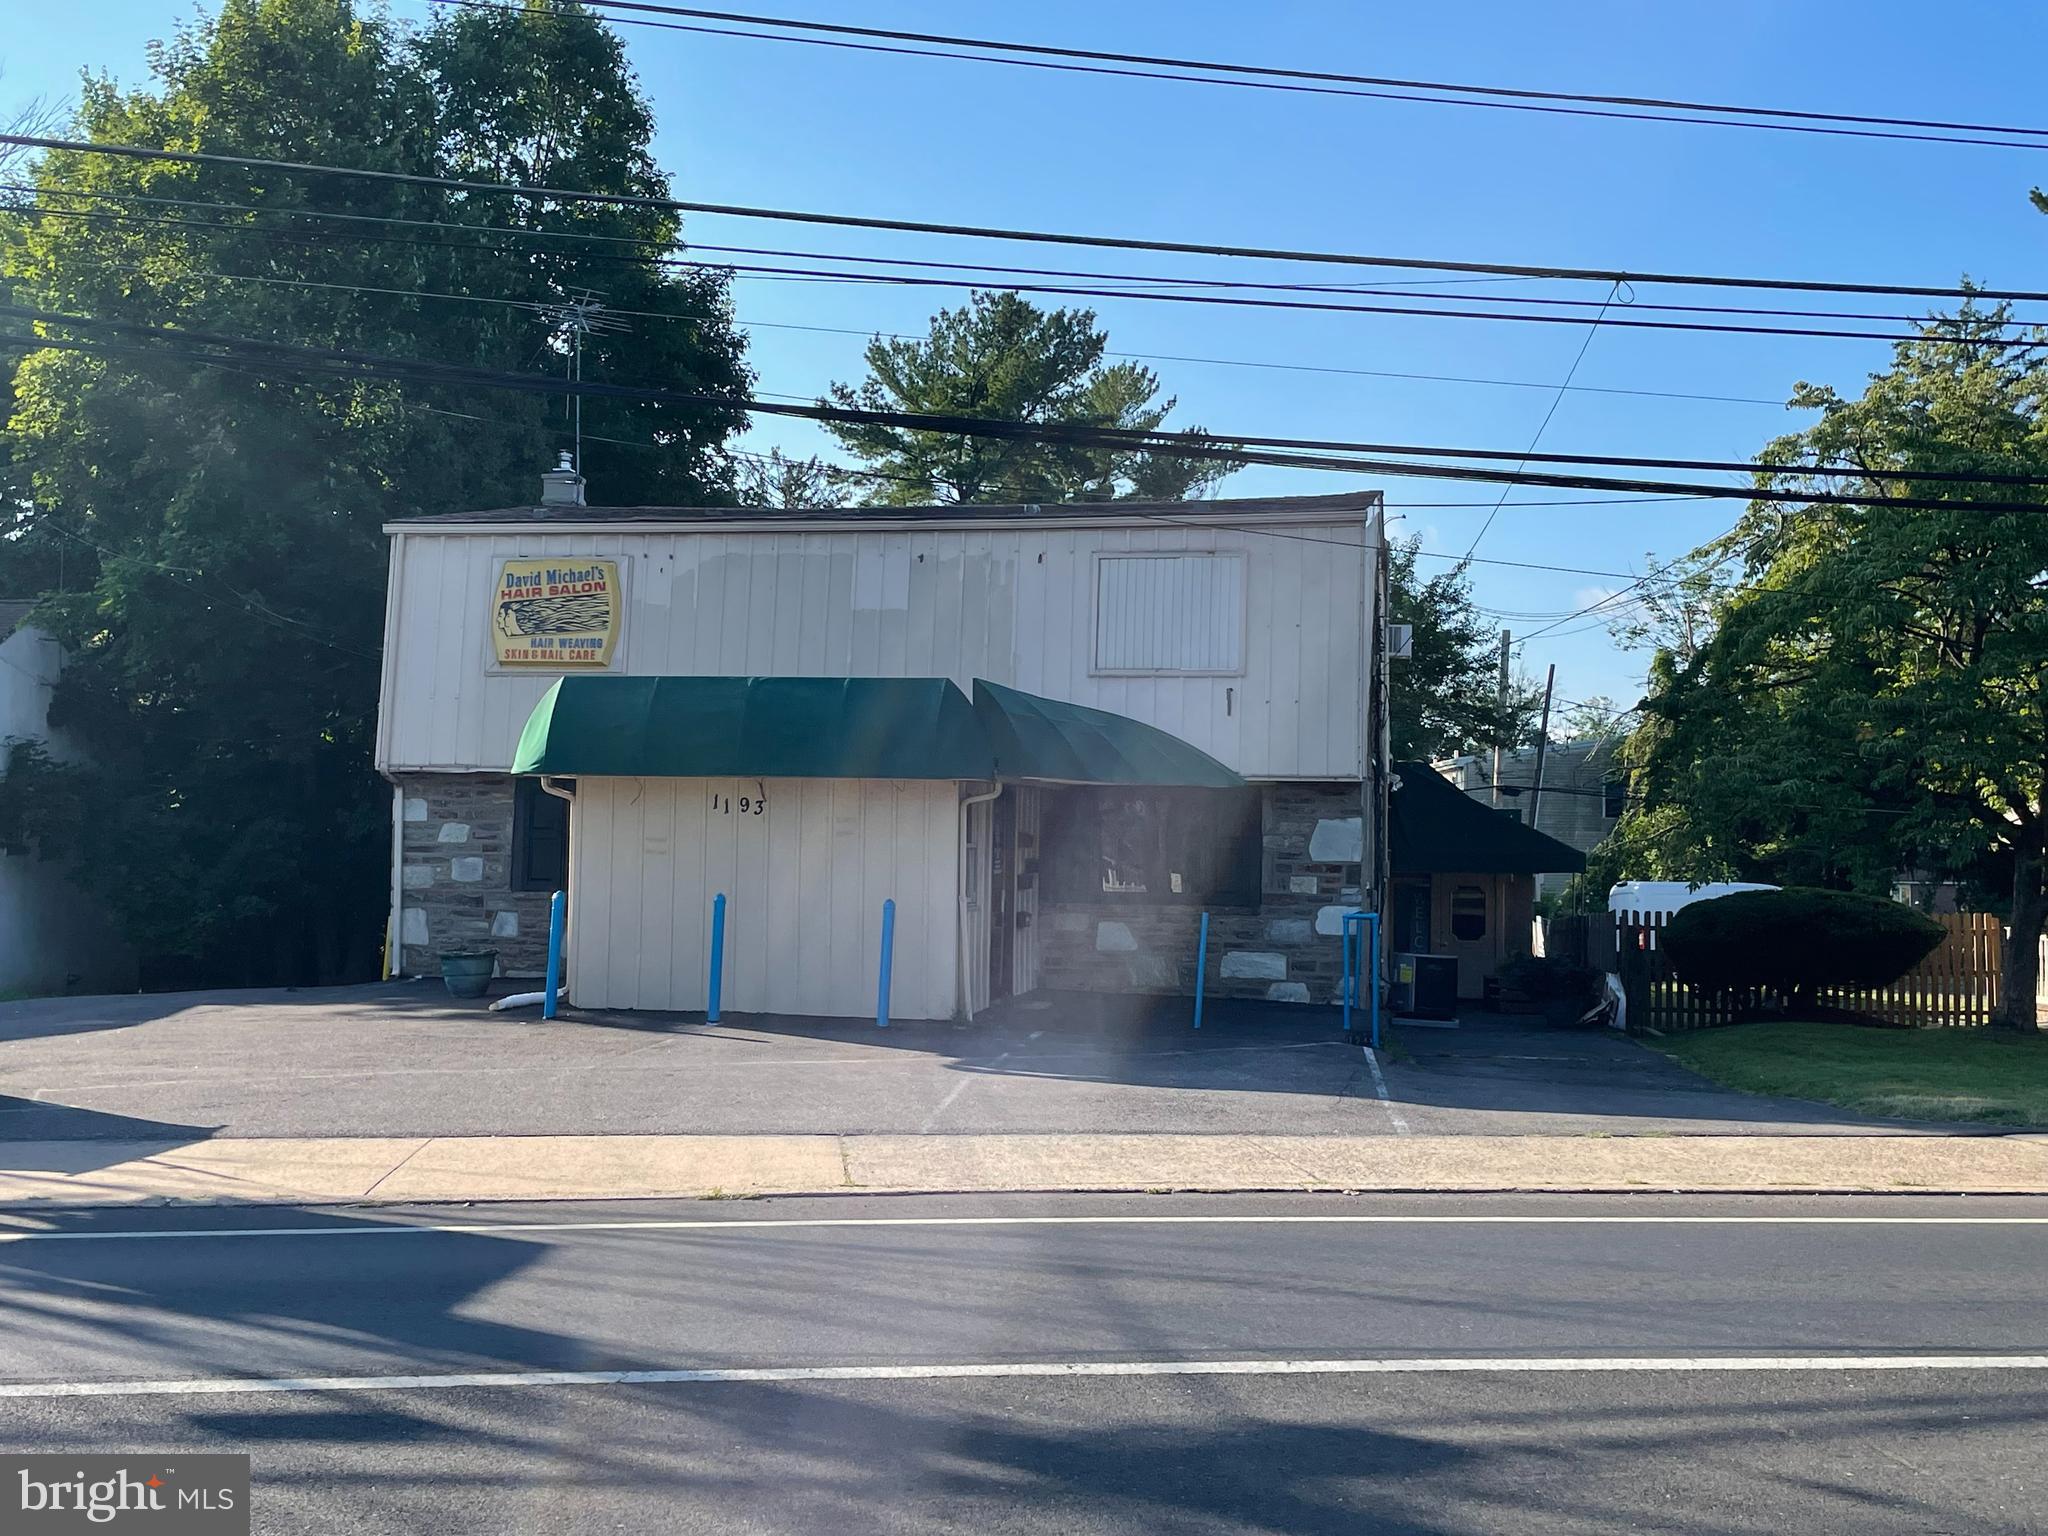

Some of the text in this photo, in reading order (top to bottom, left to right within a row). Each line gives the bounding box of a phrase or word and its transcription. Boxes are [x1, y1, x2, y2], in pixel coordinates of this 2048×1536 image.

[506, 566, 604, 588] David Michael's
[501, 581, 606, 600] HAIR SALON
[530, 638, 603, 648] HAIR WEAVING
[504, 649, 596, 660] SKIN & NAIL CARE
[713, 793, 764, 815] 1193
